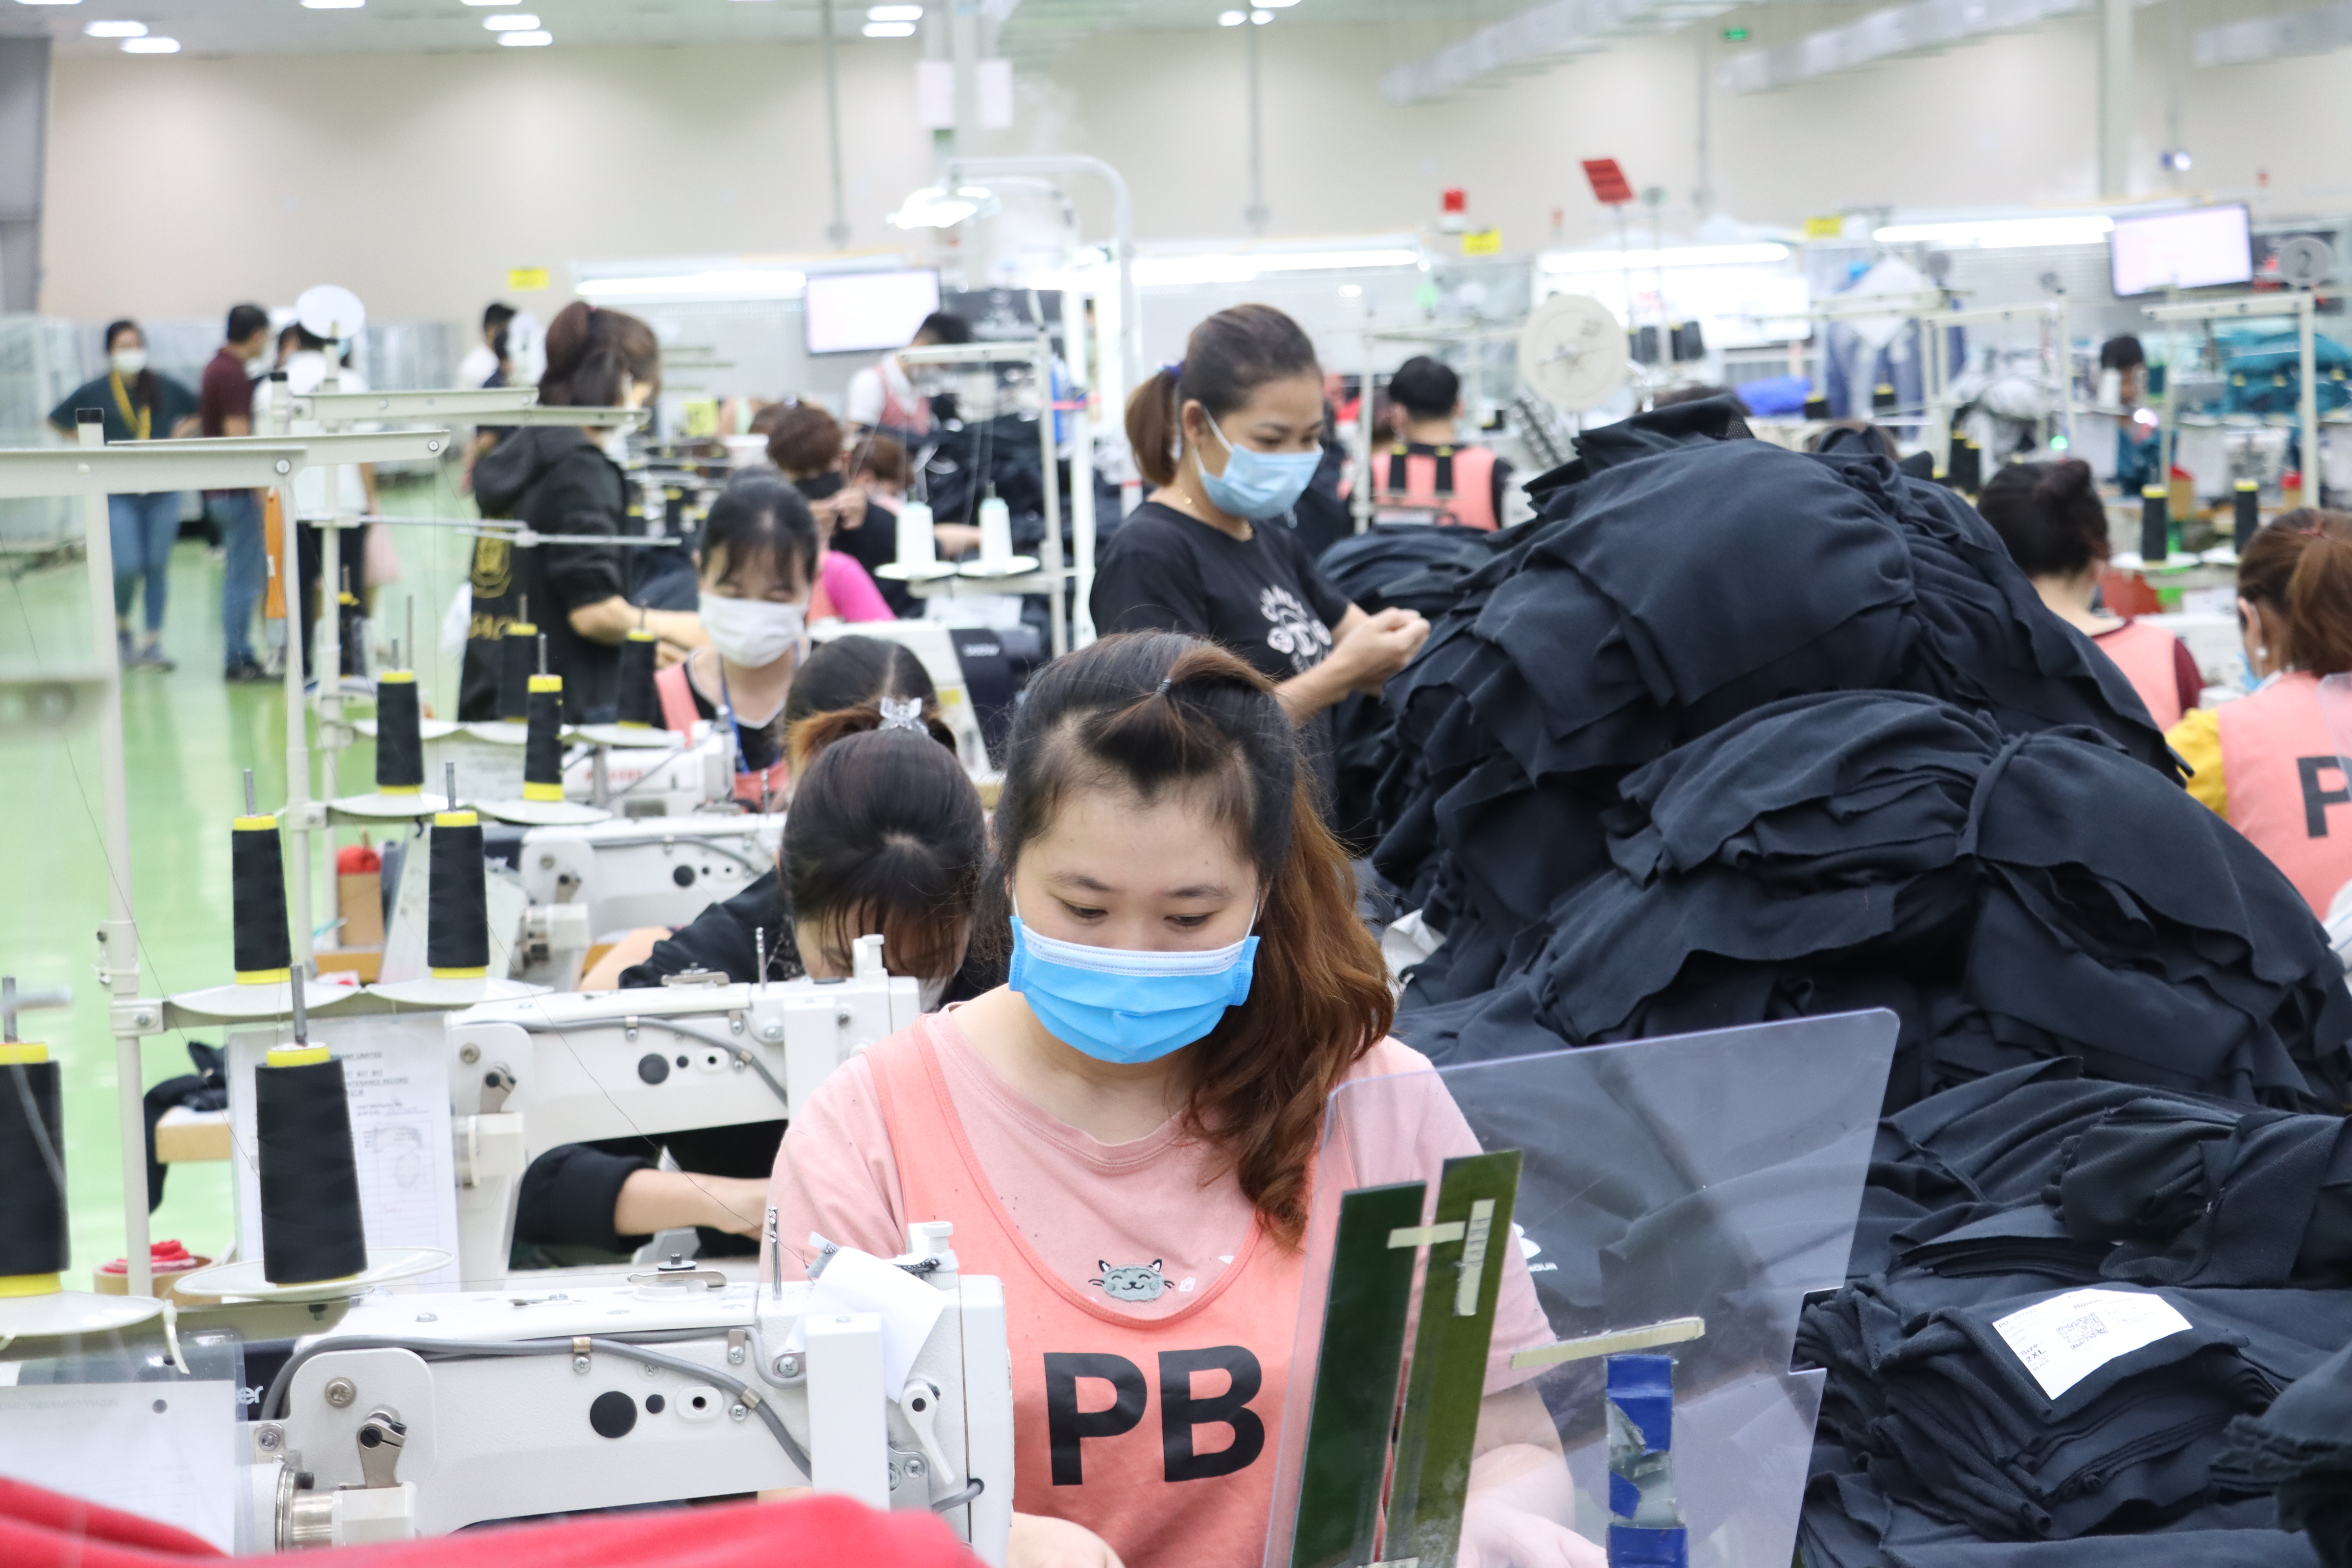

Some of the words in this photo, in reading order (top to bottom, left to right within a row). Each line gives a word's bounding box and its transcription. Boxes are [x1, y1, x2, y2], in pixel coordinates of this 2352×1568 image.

[2021, 1344, 2038, 1356] Size
[2025, 1349, 2046, 1363] 2XL
[2033, 1359, 2050, 1372] BLACK
[1043, 1345, 1266, 1486] PB
